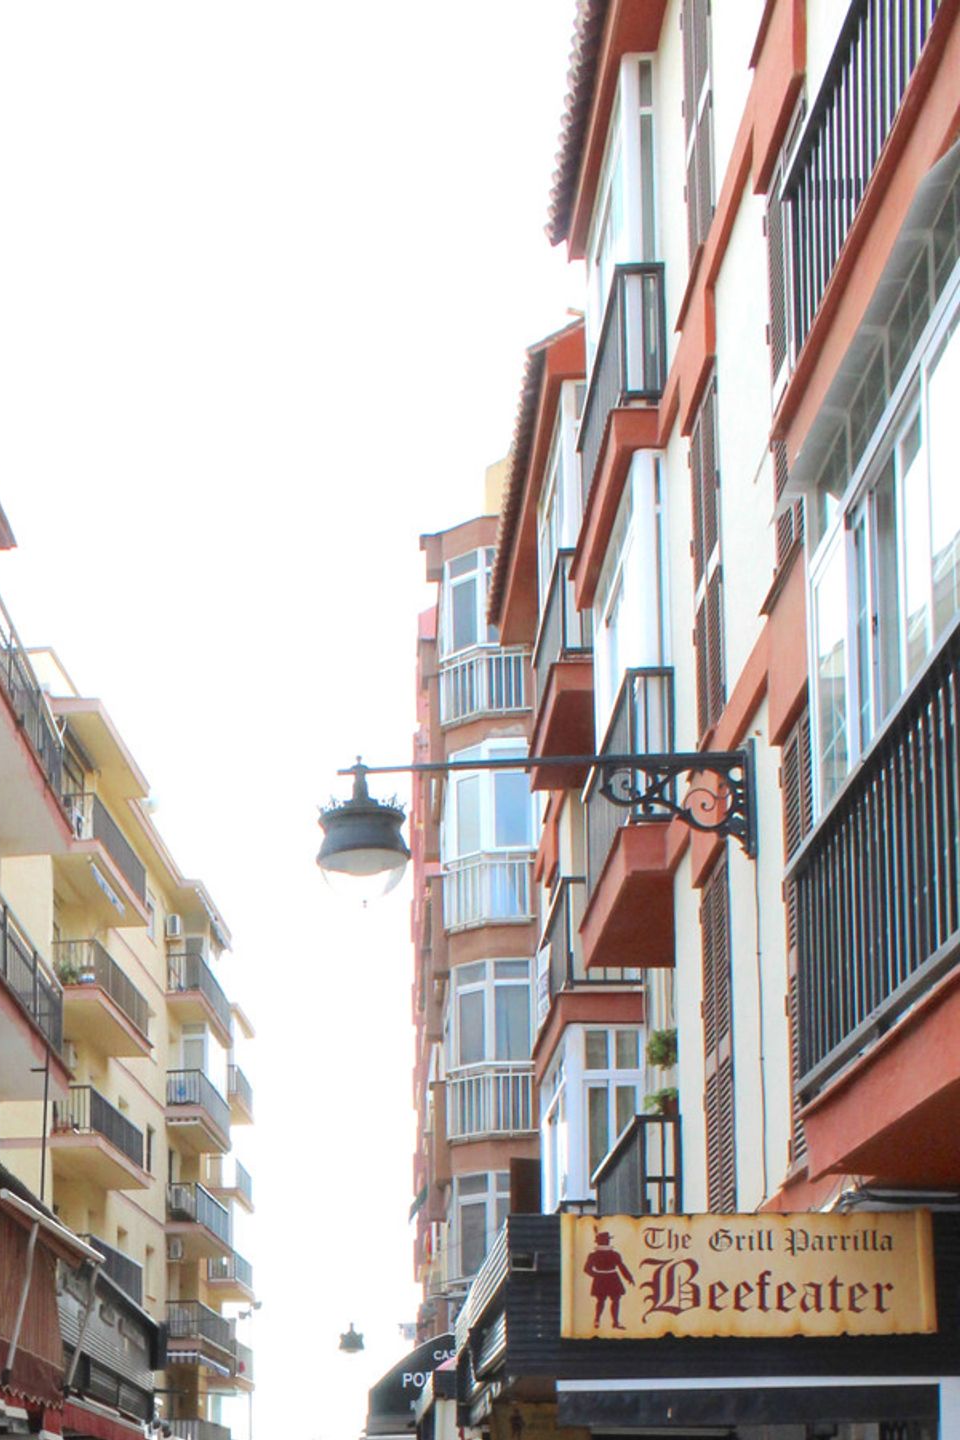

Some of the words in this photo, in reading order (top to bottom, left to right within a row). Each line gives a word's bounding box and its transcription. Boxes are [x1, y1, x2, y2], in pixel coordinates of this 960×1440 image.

[643, 1227, 692, 1251] The
[709, 1227, 773, 1253] Grill
[784, 1227, 894, 1256] Parrilla
[640, 1257, 894, 1324] Beefeater
